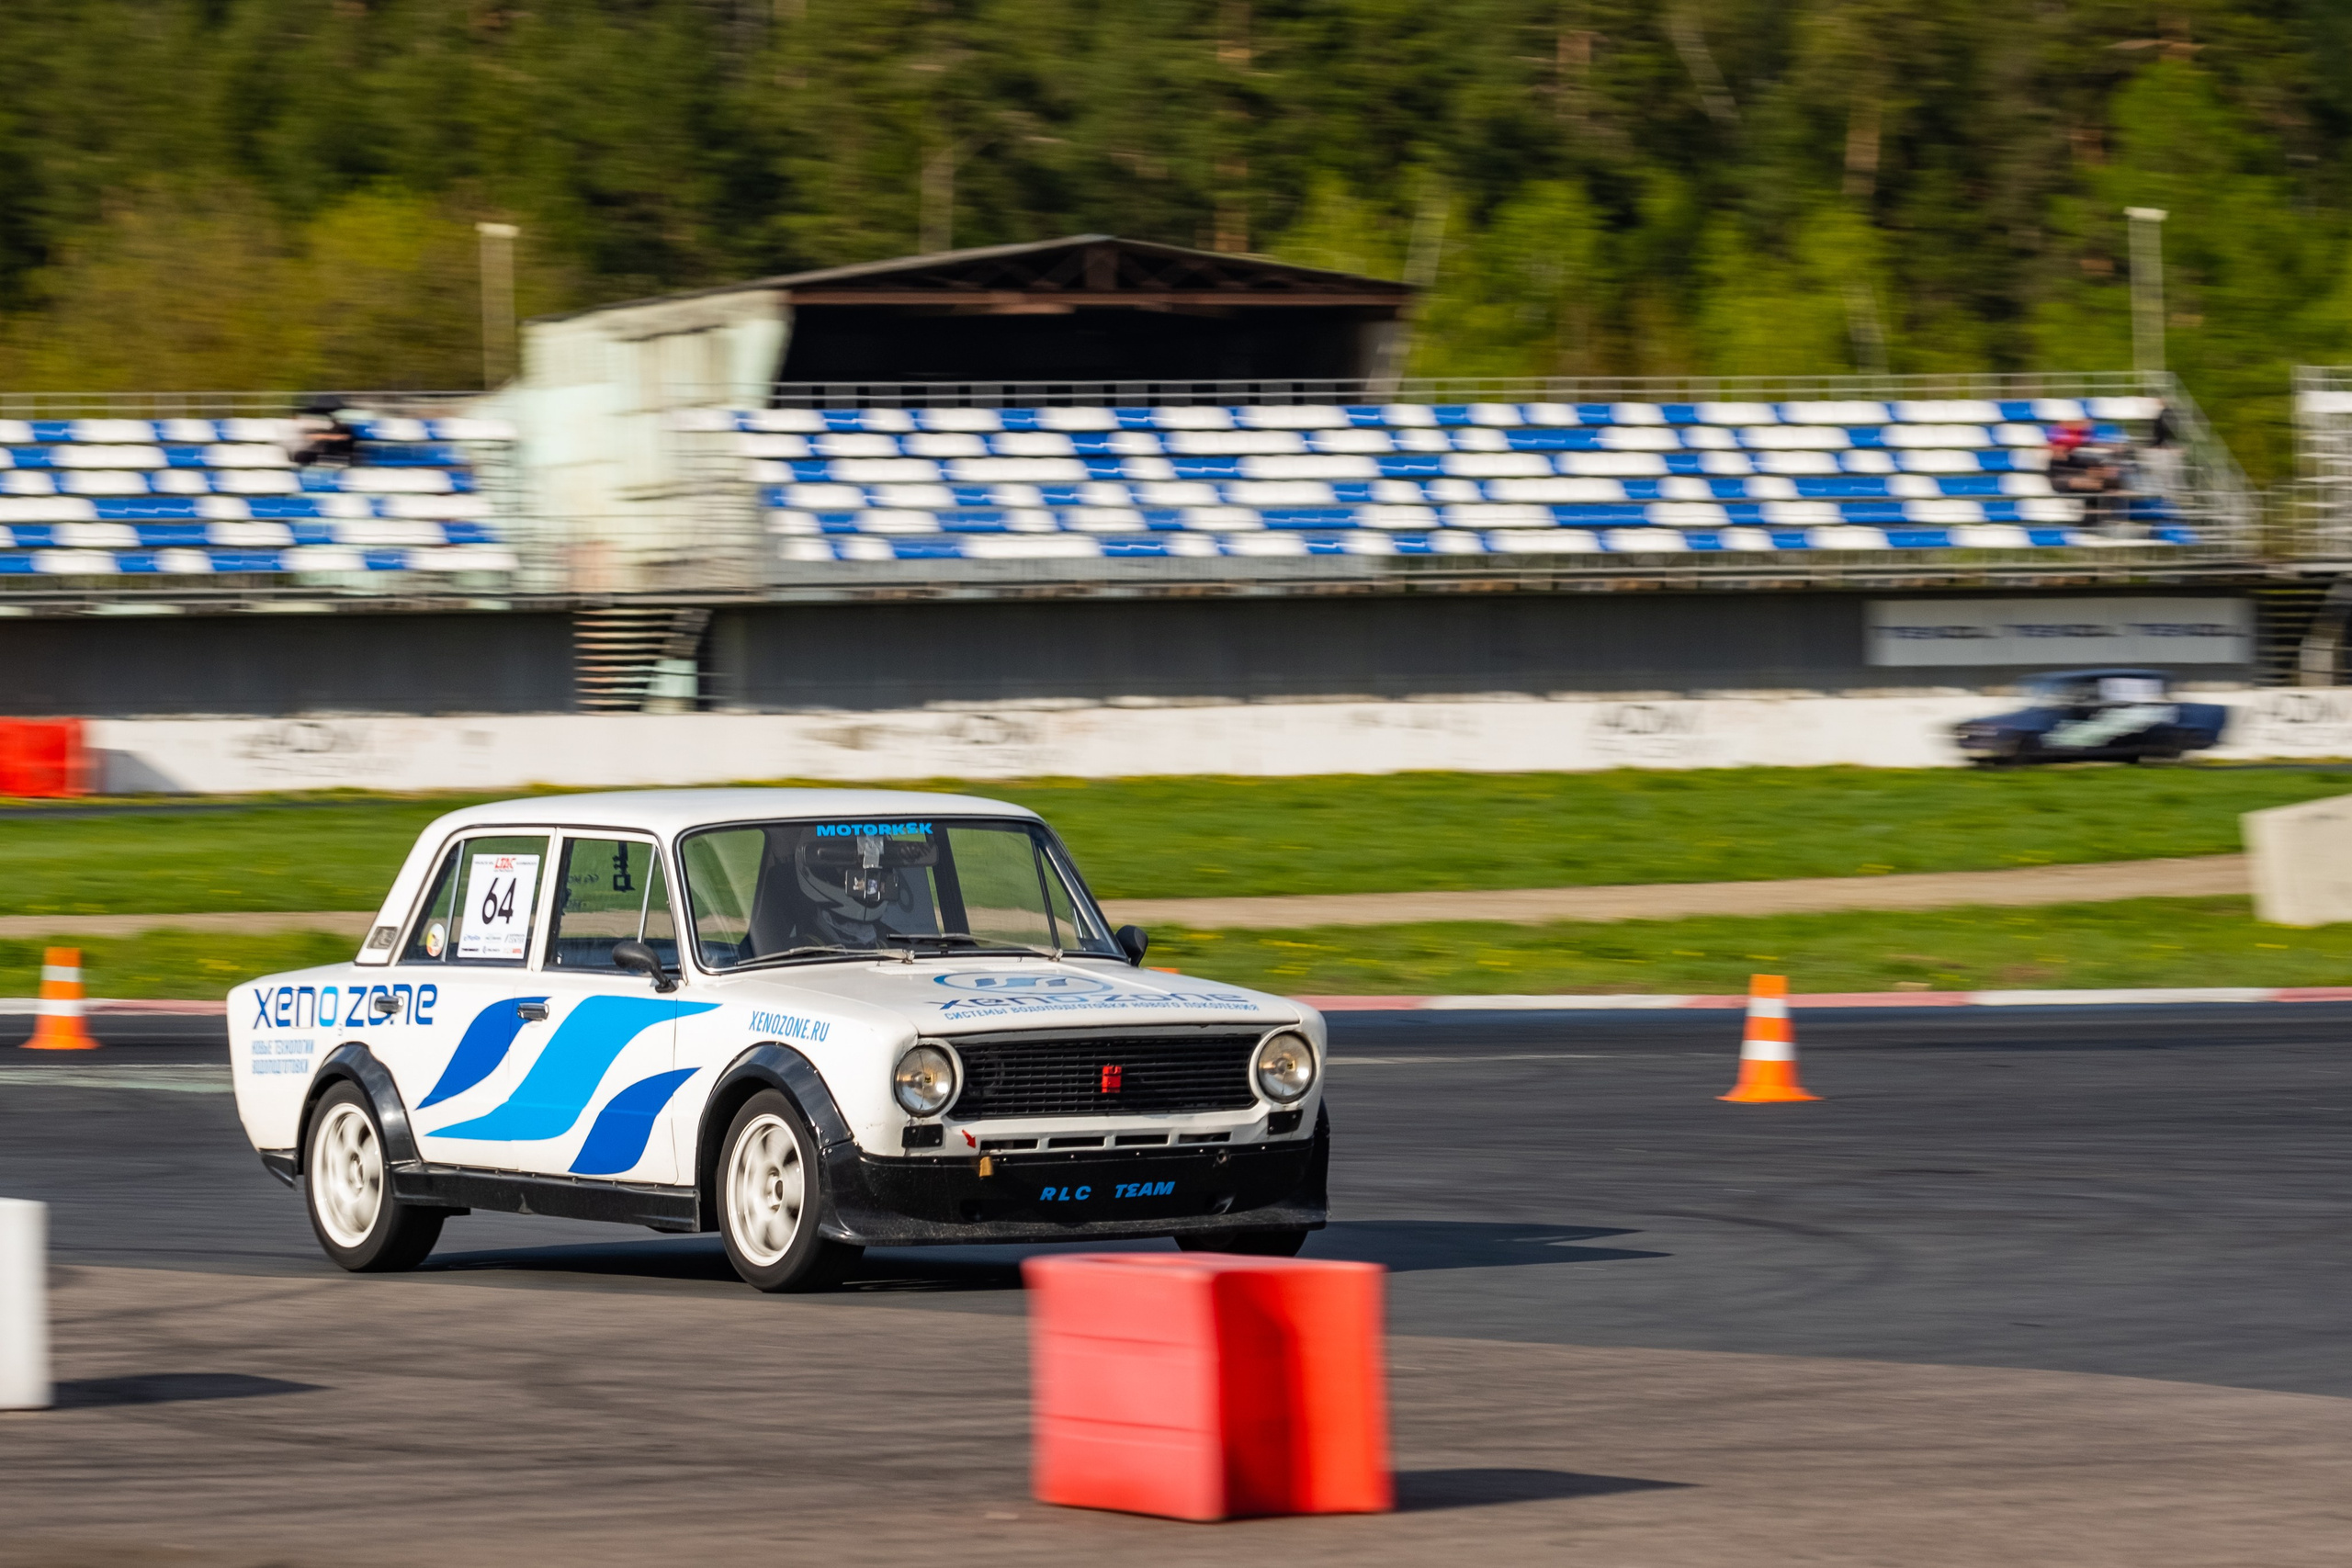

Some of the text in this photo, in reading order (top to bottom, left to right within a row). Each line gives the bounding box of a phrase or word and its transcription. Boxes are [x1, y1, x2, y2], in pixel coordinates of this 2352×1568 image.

[481, 877, 516, 924] 64
[944, 1008, 1007, 1021] СИСТЕМЫ
[1011, 1000, 1128, 1013] ВОДОПОДГОТОВКИ
[1183, 1001, 1260, 1011] ПОКОЛЕНИЯ
[749, 1010, 831, 1043] XENOZONE.RU
[1040, 1181, 1176, 1201] RLC TEAM
